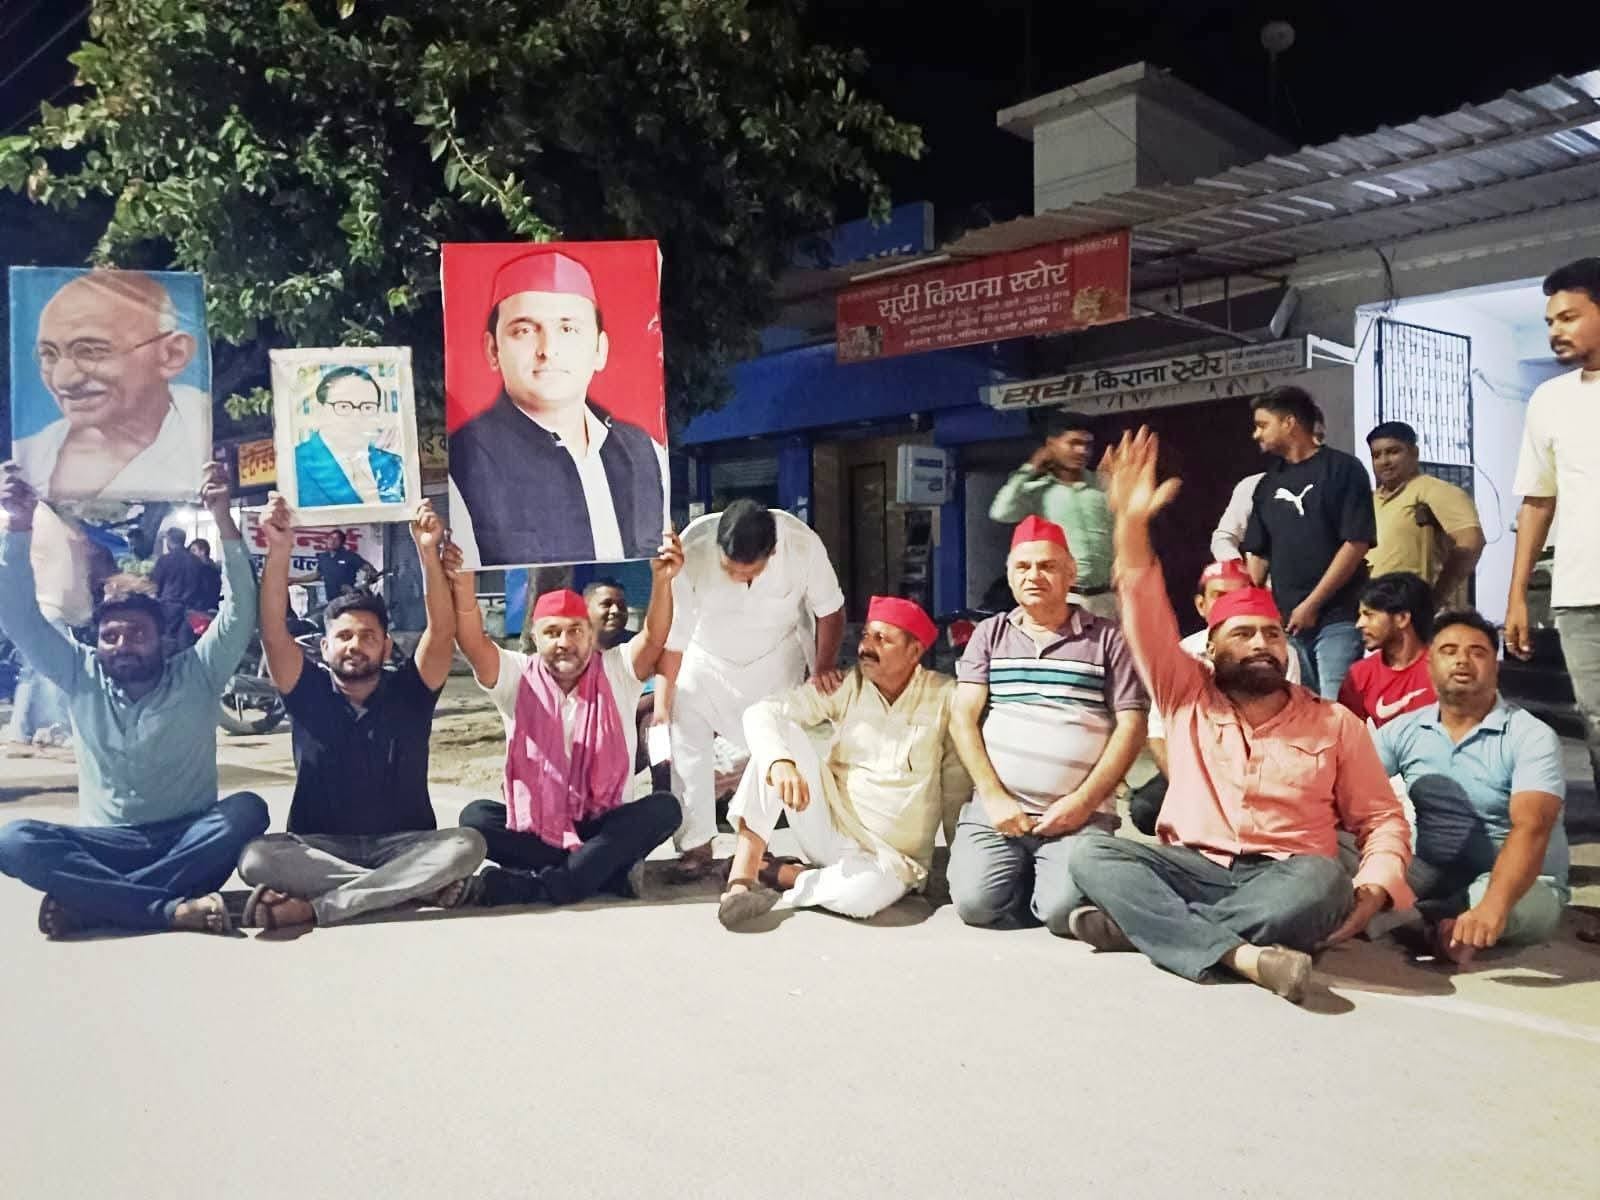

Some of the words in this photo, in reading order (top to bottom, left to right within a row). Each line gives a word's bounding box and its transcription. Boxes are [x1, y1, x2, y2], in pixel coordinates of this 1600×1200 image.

[877, 284, 920, 324] सूरी
[924, 276, 1003, 309] किराना
[1008, 260, 1069, 292] स्टोर
[1002, 374, 1086, 405] सूरी
[1094, 365, 1168, 391] किराना
[1171, 354, 1224, 382] स्टोर
